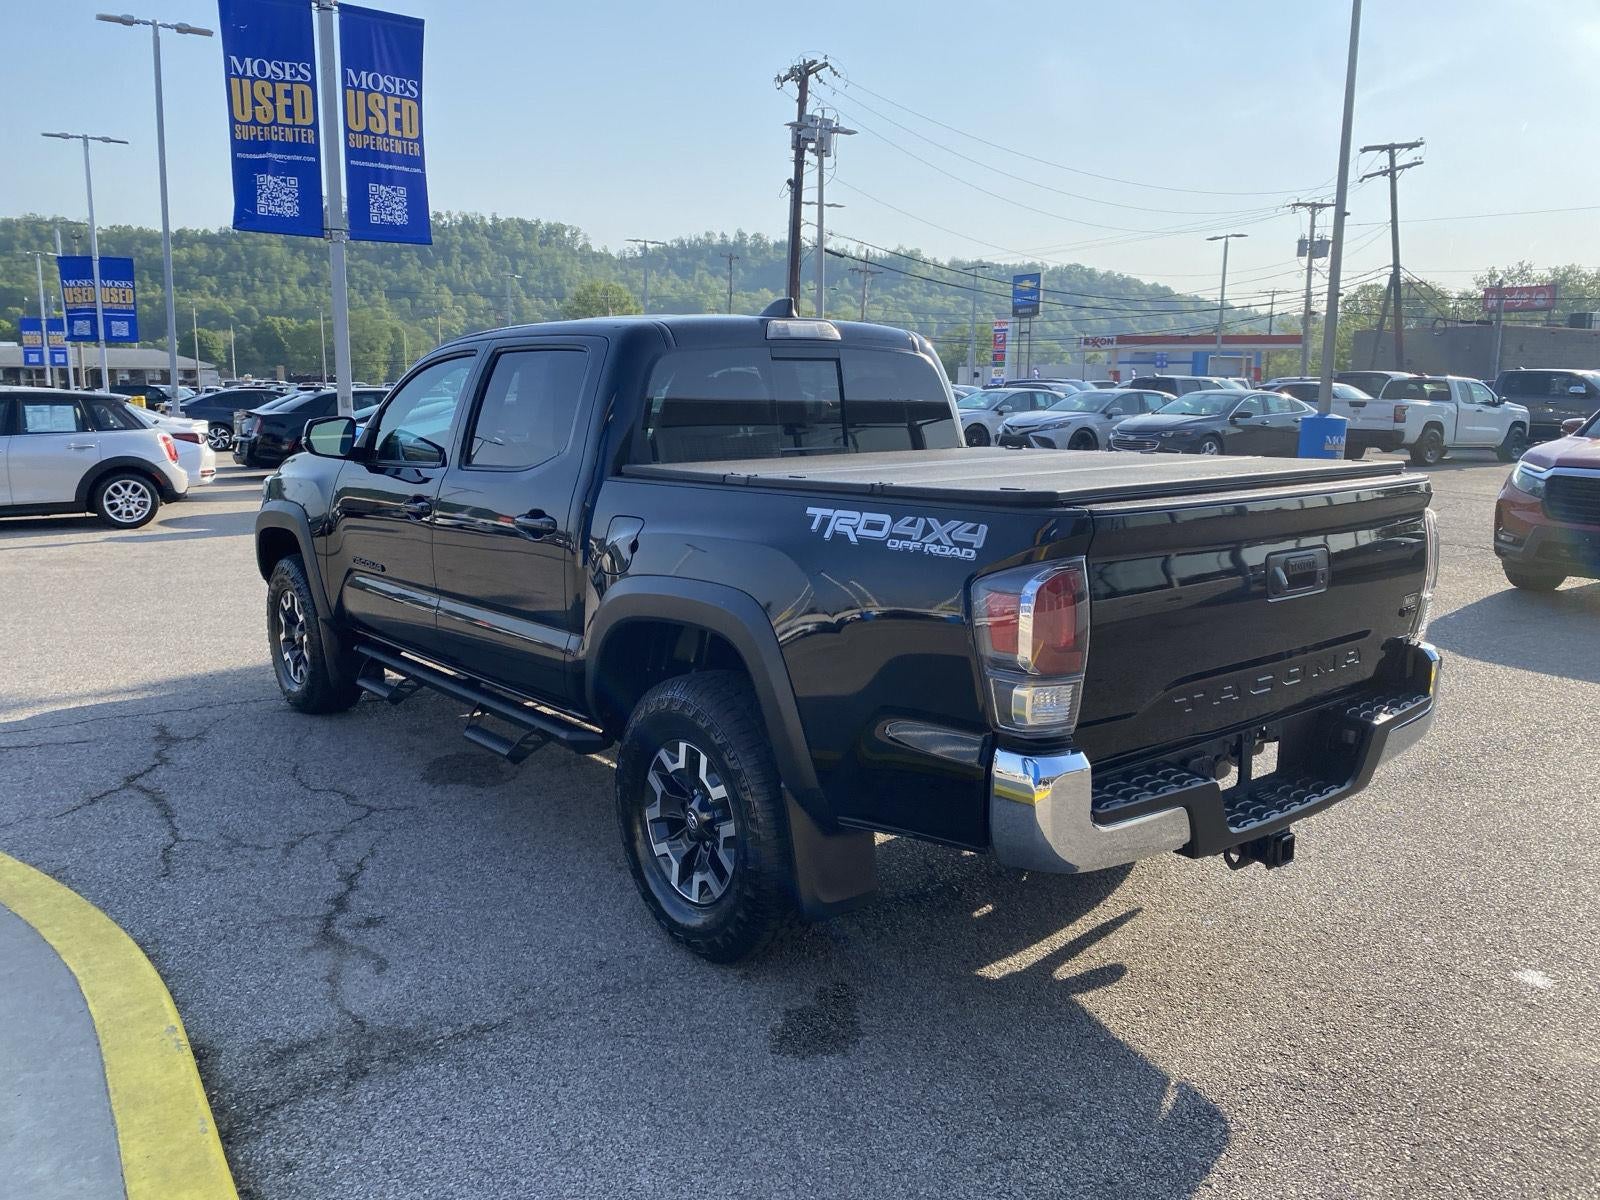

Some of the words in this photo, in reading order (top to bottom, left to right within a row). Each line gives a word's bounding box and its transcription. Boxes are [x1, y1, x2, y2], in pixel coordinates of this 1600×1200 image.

[229, 55, 312, 82] MOSES
[346, 67, 418, 98] MOSES
[230, 78, 314, 126] USED
[346, 89, 420, 140] USED
[234, 124, 315, 145] SUPERCENTER
[348, 133, 420, 157] SUPERCENTER
[63, 279, 95, 288] MOSES
[63, 287, 96, 303] USED
[101, 279, 133, 288] MOSES
[101, 287, 134, 304] USED
[1487, 290, 1530, 308] Wndy's
[805, 506, 894, 545] TRD
[1172, 647, 1362, 713] TACOMA
